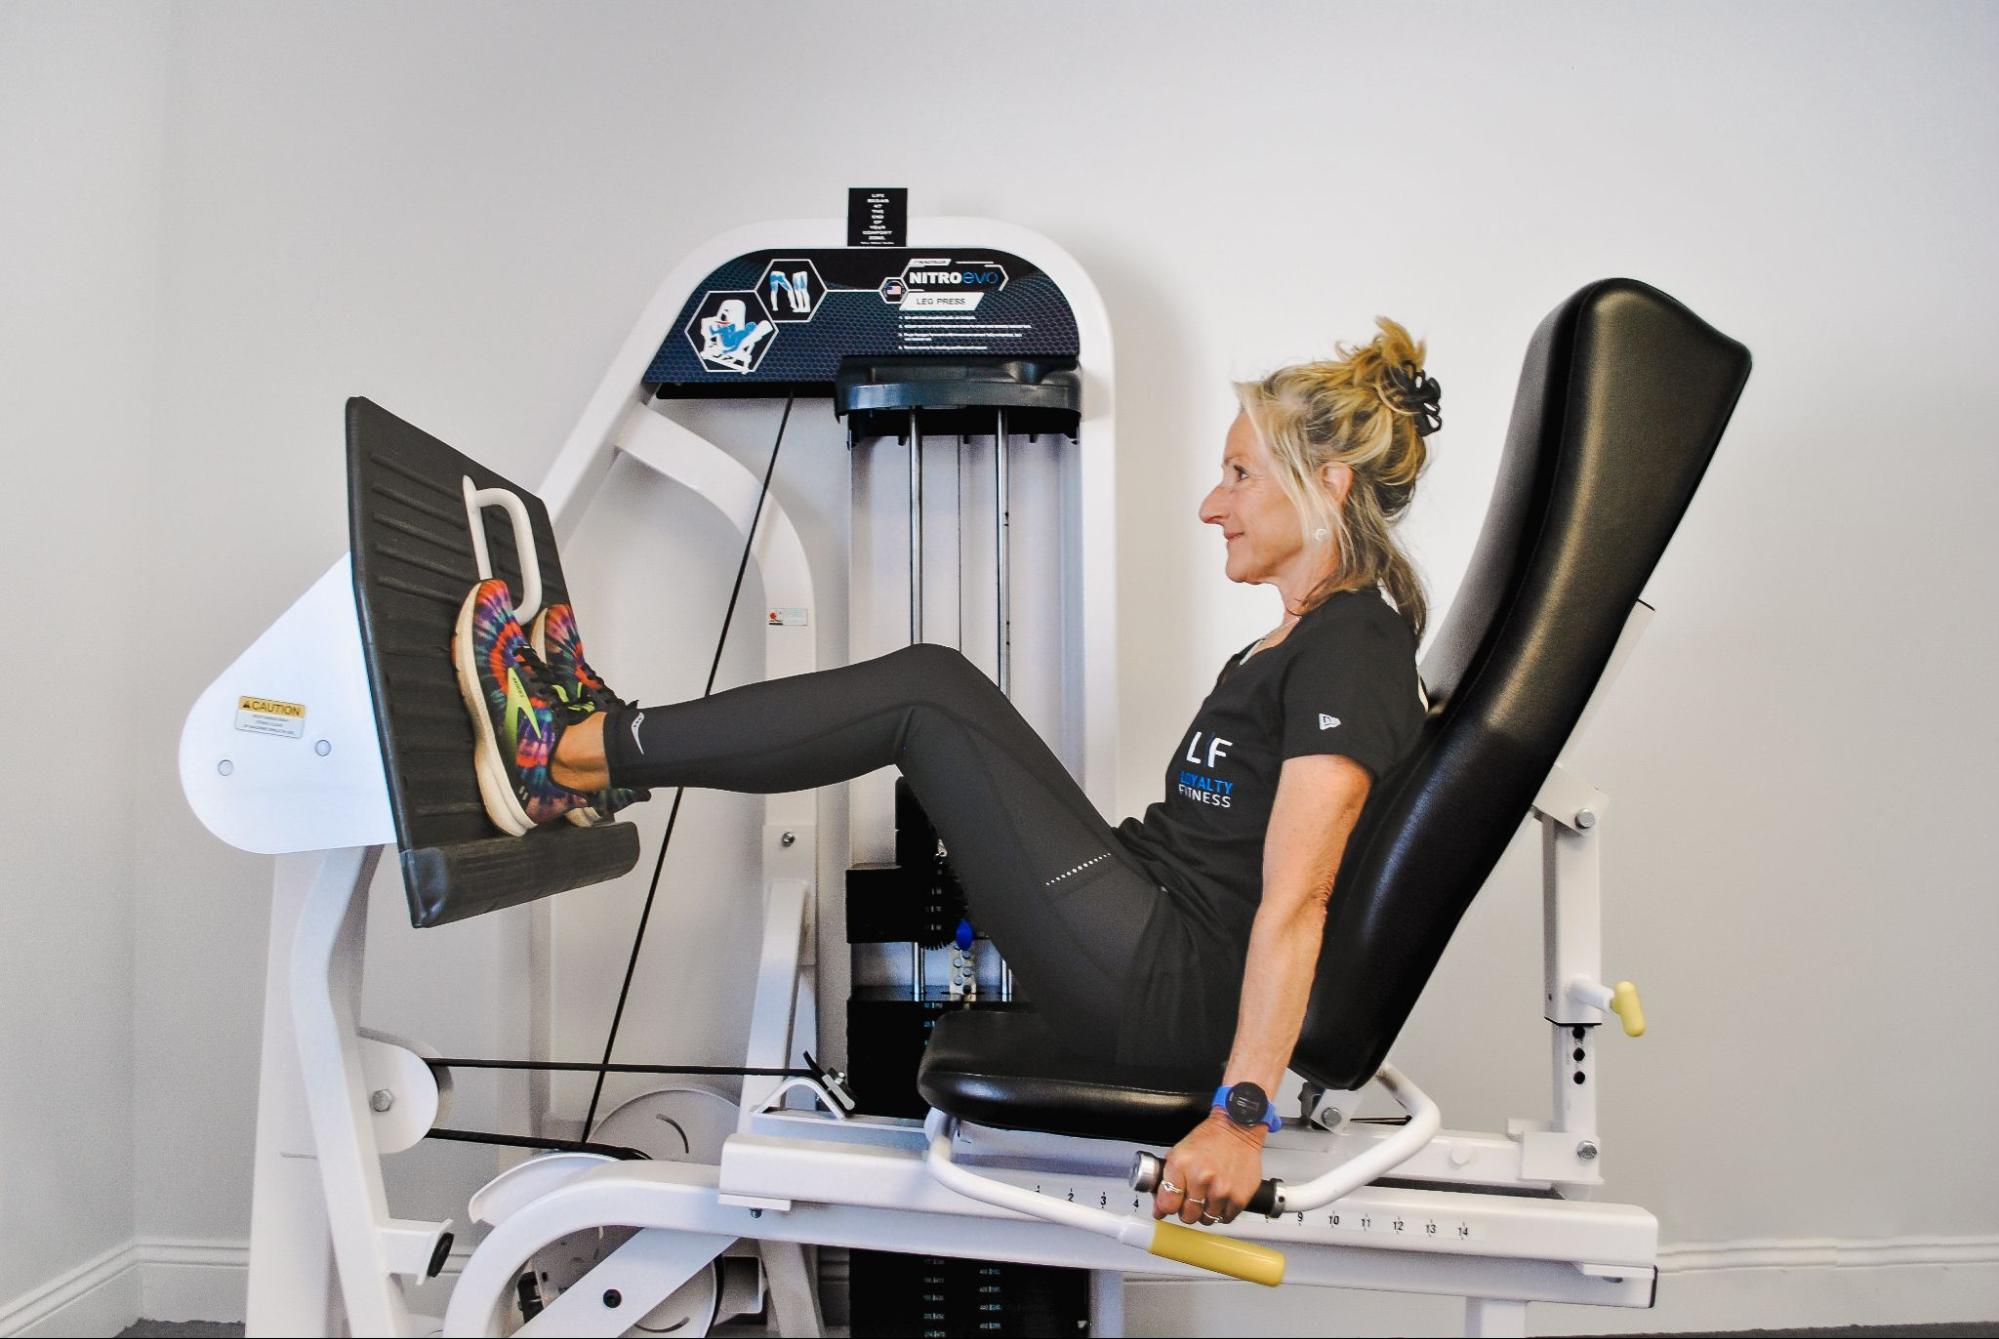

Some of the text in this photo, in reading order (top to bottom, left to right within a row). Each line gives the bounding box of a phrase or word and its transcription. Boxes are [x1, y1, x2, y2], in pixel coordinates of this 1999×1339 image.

[252, 700, 300, 716] CAUTION
[1180, 771, 1234, 795] LOYALTY
[1178, 784, 1231, 808] FITNESS
[1068, 1192, 1468, 1236] 2 3 4 9 10 11 12 13 14
